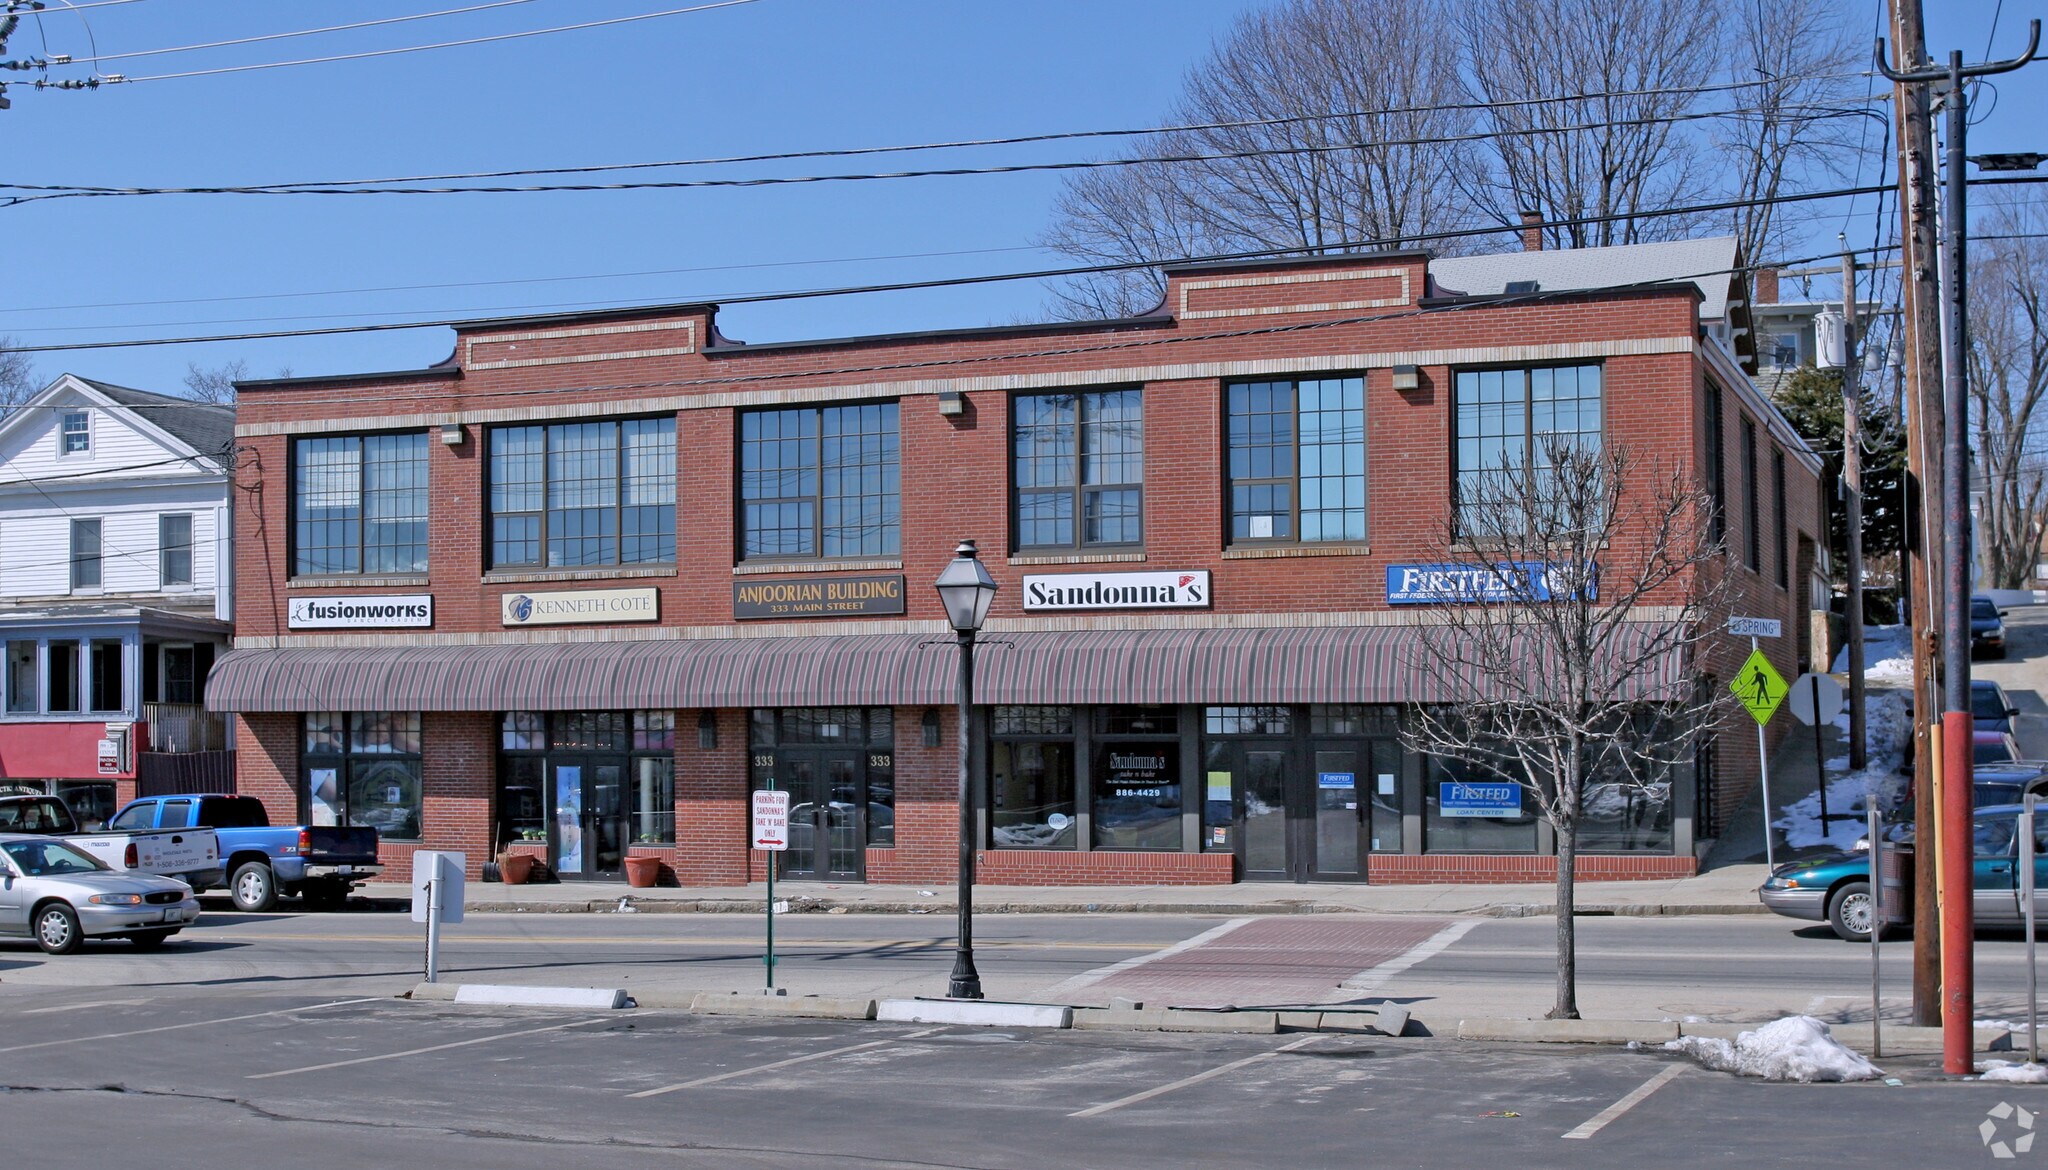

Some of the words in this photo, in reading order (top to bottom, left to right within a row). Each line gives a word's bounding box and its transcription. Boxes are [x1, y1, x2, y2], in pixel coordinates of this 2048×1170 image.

[737, 584, 822, 606] ANJOORIAN
[827, 580, 898, 600] BUILDING
[308, 601, 427, 619] fusionworks
[536, 599, 606, 614] KENNETH
[770, 604, 789, 613] 333
[792, 603, 823, 612] MAIN
[826, 601, 865, 610] STREET
[1743, 620, 1774, 634] SPRING
[755, 755, 774, 767] 333
[871, 755, 890, 767] 333
[1116, 788, 1160, 797] 886-4429
[755, 795, 775, 804] PARKING
[776, 796, 785, 804] FOR
[755, 818, 766, 826] TAKE
[774, 818, 785, 826] BAKE
[764, 829, 776, 837] ONLY
